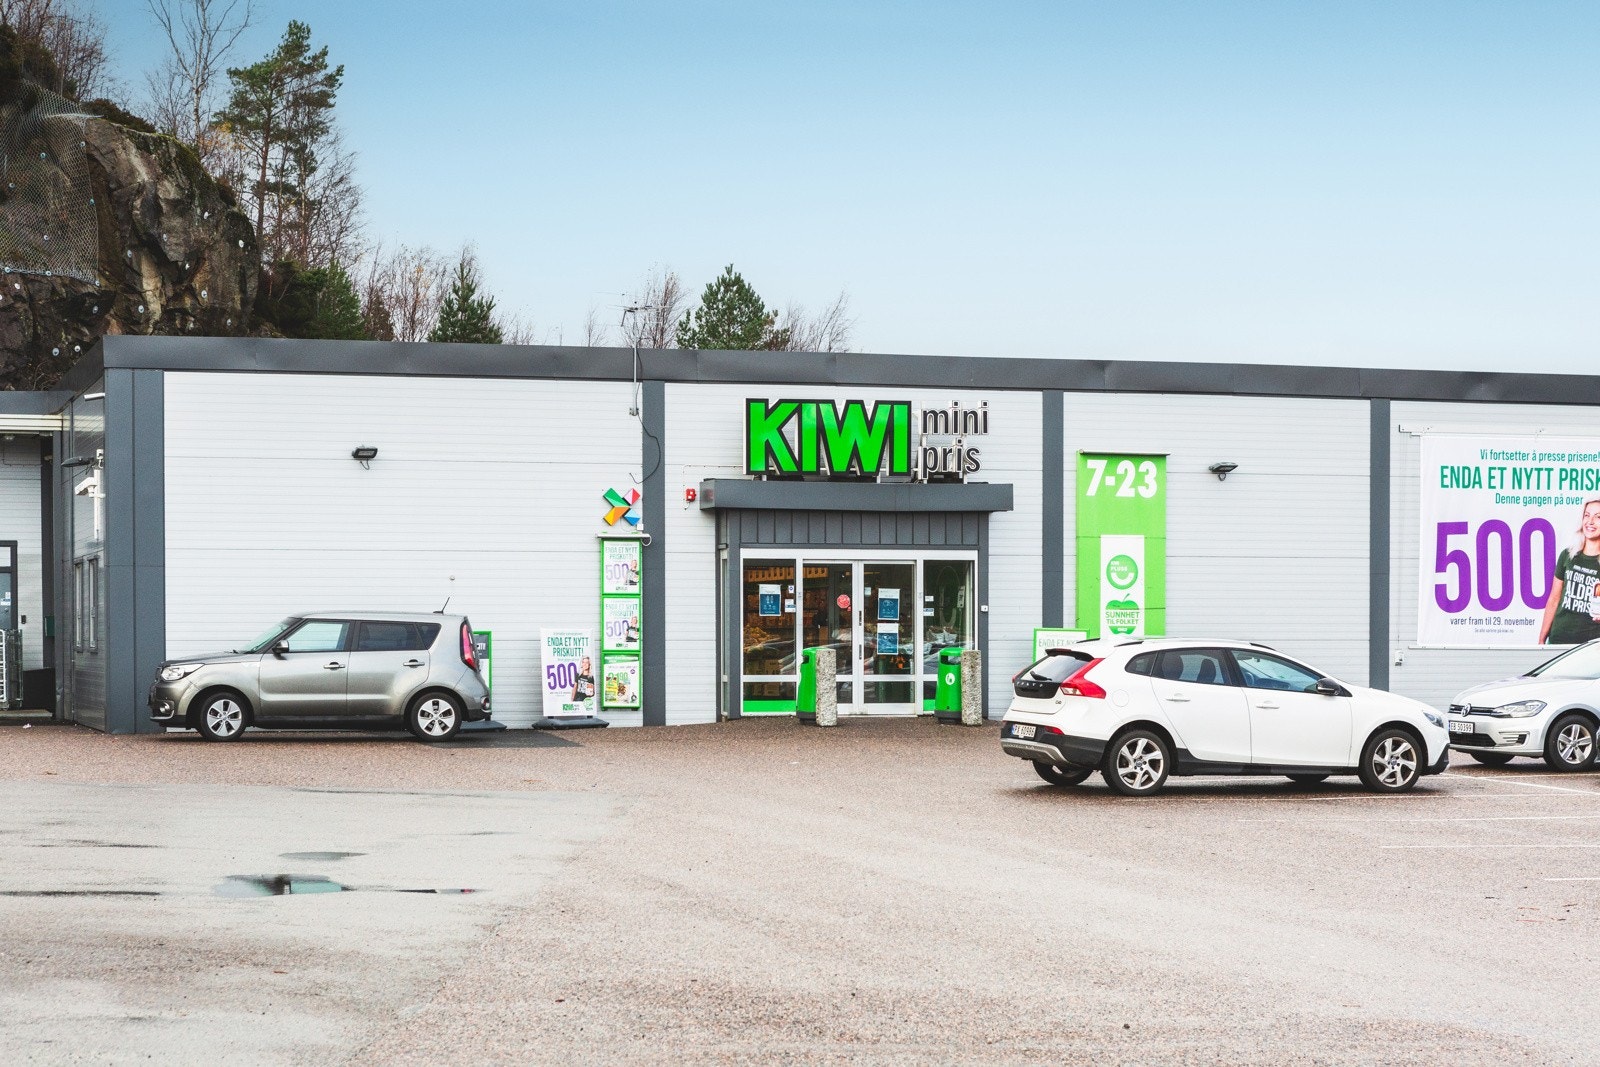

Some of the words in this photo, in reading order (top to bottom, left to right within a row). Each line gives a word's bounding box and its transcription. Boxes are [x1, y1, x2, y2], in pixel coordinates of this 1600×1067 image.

[921, 400, 989, 435] mini
[746, 398, 911, 476] KIWI
[921, 438, 981, 480] pris
[1480, 449, 1488, 460] Vi
[1490, 449, 1530, 461] fortsetter
[1532, 450, 1537, 461] å
[1539, 452, 1566, 463] presse
[1086, 459, 1158, 499] 7-23
[1440, 465, 1483, 489] ENDA
[1488, 466, 1507, 490] ET
[1512, 467, 1554, 490] NYTT
[1495, 493, 1521, 504] Denne
[1523, 495, 1552, 506] gangen
[1554, 494, 1564, 506] på
[1566, 497, 1583, 505] over
[605, 563, 629, 581] 500
[1434, 518, 1556, 613] 500
[1105, 611, 1140, 619] SUNNHET
[1450, 617, 1467, 625] varer
[1469, 616, 1483, 625] fram
[1504, 617, 1536, 626] november
[605, 620, 629, 637] 500
[547, 637, 563, 647] ENDA
[564, 637, 572, 647] ET
[573, 637, 589, 647] NYTT
[553, 647, 584, 657] PRISKUTT!
[546, 662, 578, 690] 500
